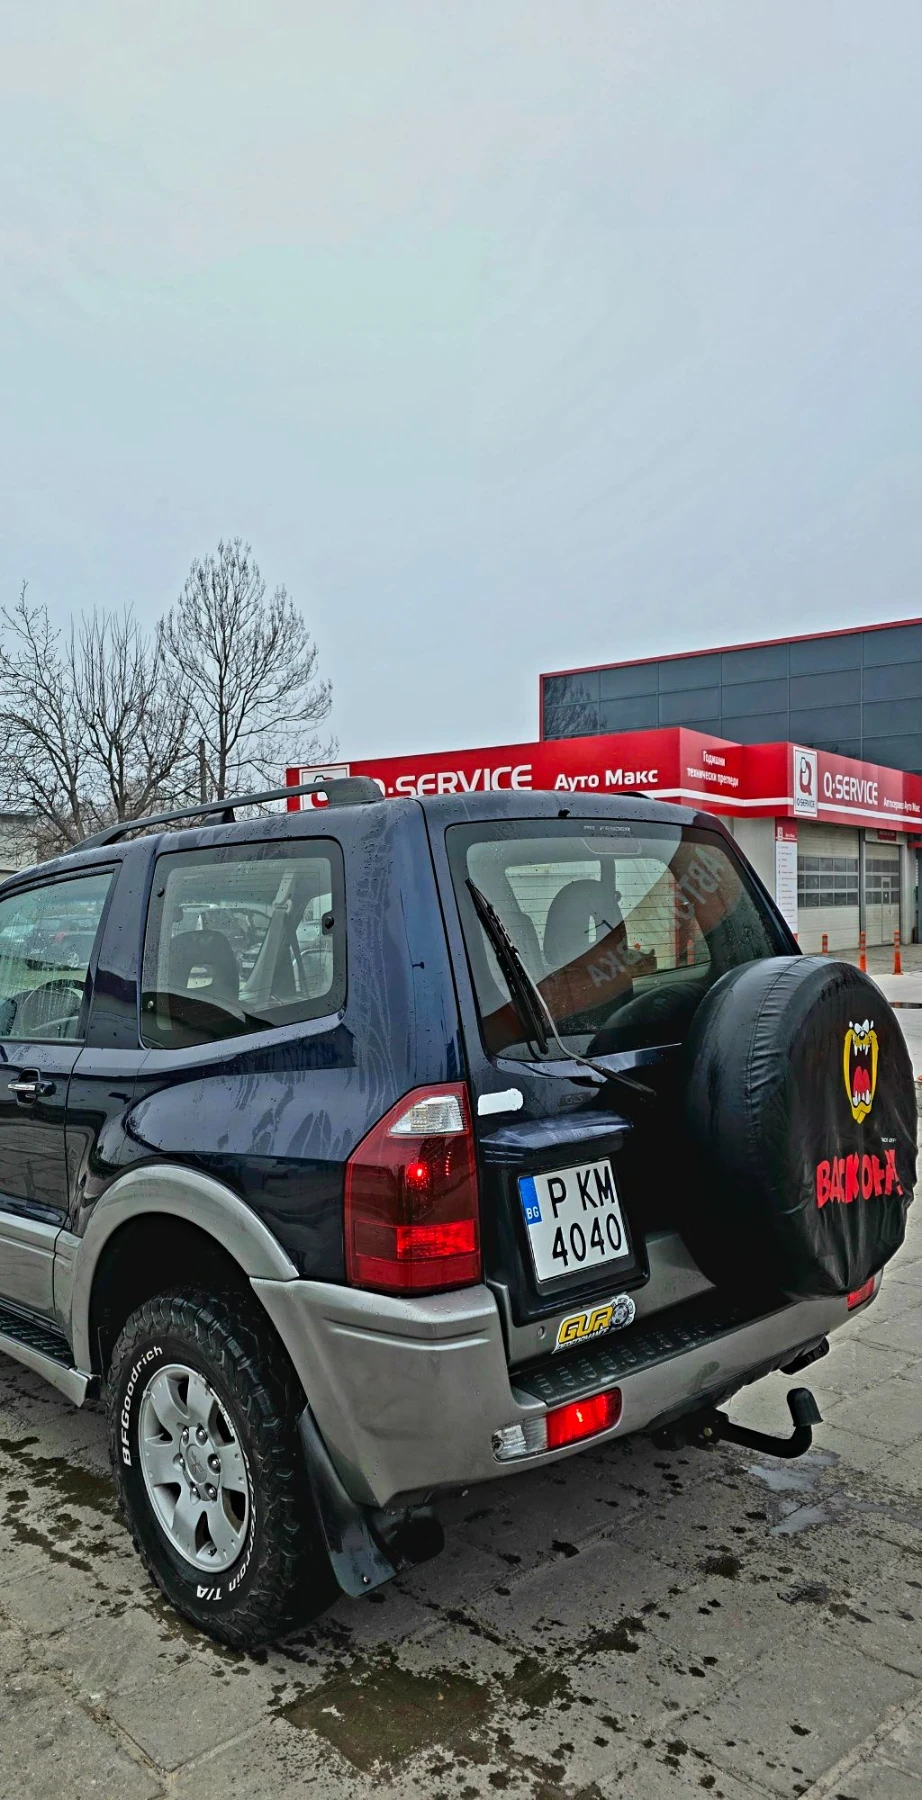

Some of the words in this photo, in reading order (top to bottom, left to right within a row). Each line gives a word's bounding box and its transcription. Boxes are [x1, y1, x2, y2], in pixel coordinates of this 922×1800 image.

[554, 773, 600, 792] Ауто
[605, 768, 659, 787] Макс
[546, 1177, 567, 1219] P
[576, 1166, 616, 1211] KM
[526, 1206, 540, 1221] BG
[552, 1213, 622, 1267] 4040
[121, 1346, 163, 1467] BFGoodrich
[196, 1585, 222, 1601] T/A
